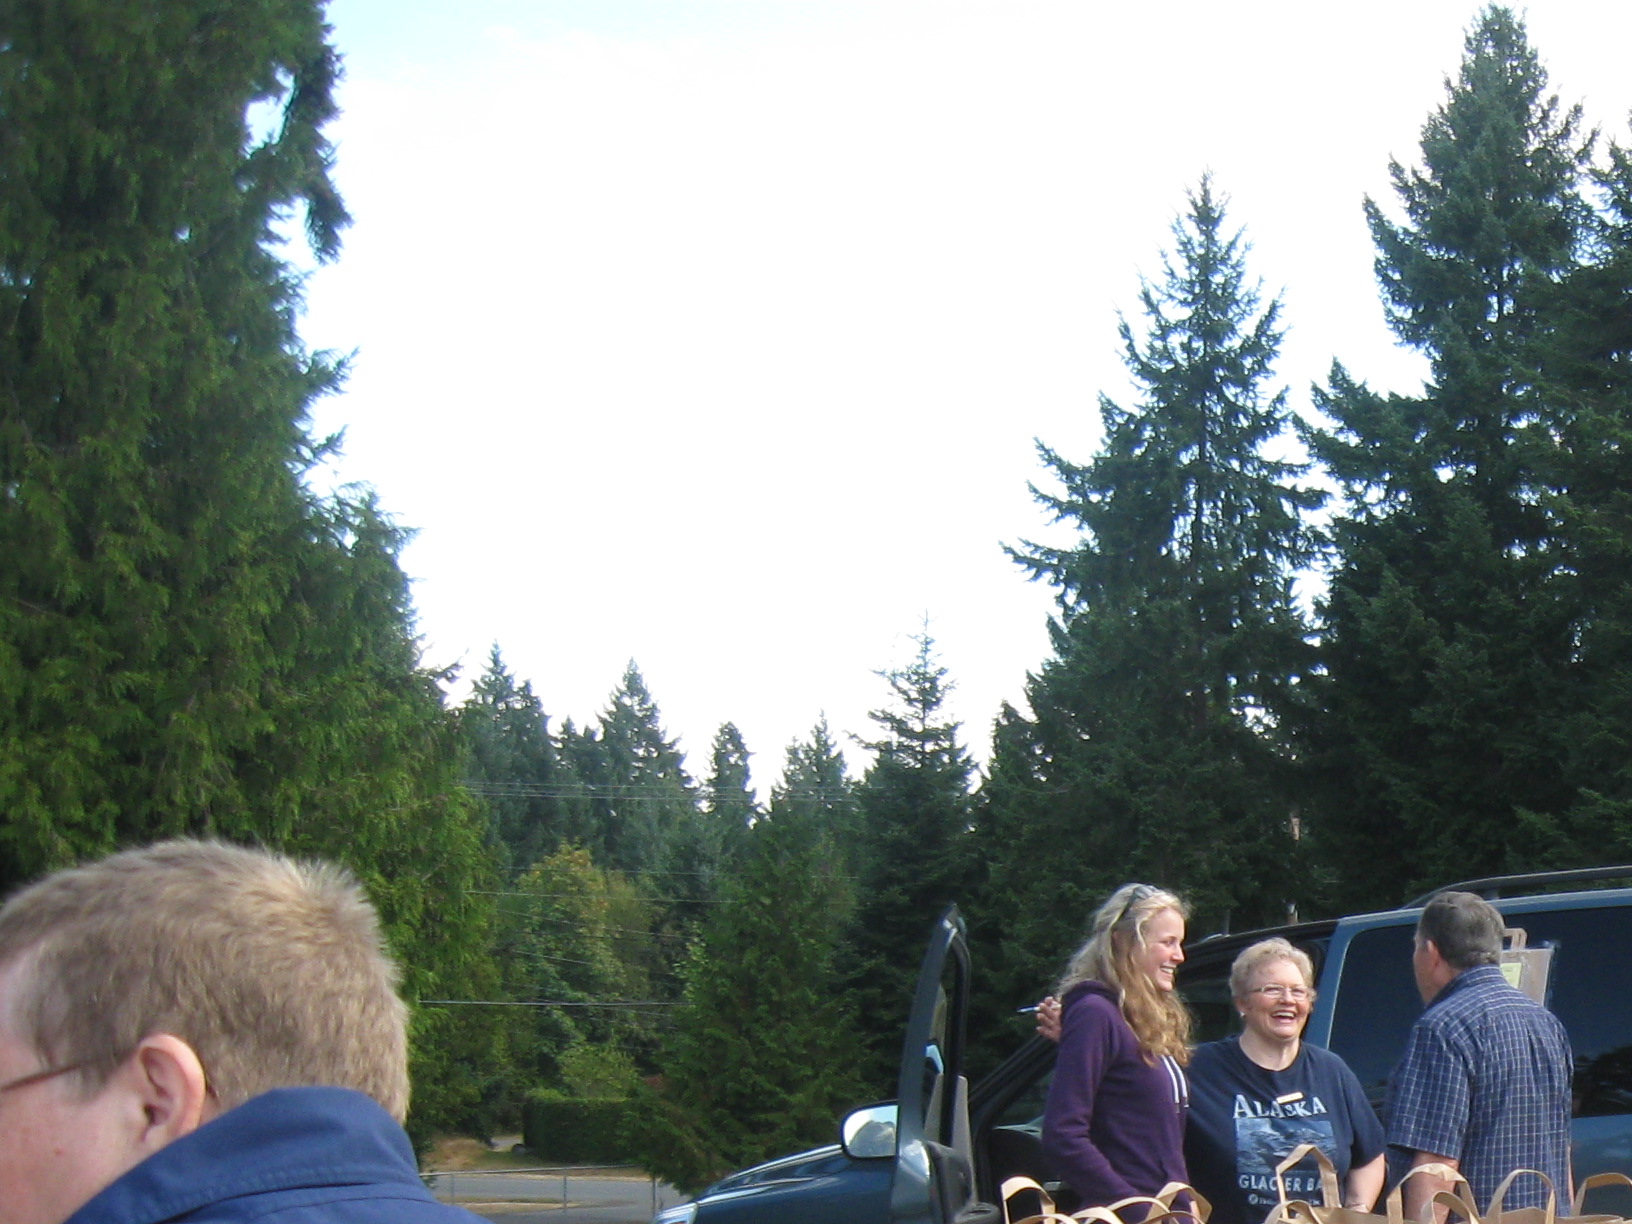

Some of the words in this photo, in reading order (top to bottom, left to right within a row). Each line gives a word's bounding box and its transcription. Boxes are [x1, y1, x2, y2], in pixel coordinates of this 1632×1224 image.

[1233, 1093, 1327, 1120] ALASKA
[1238, 1174, 1301, 1192] GLACER
[1306, 1177, 1325, 1192] BA
